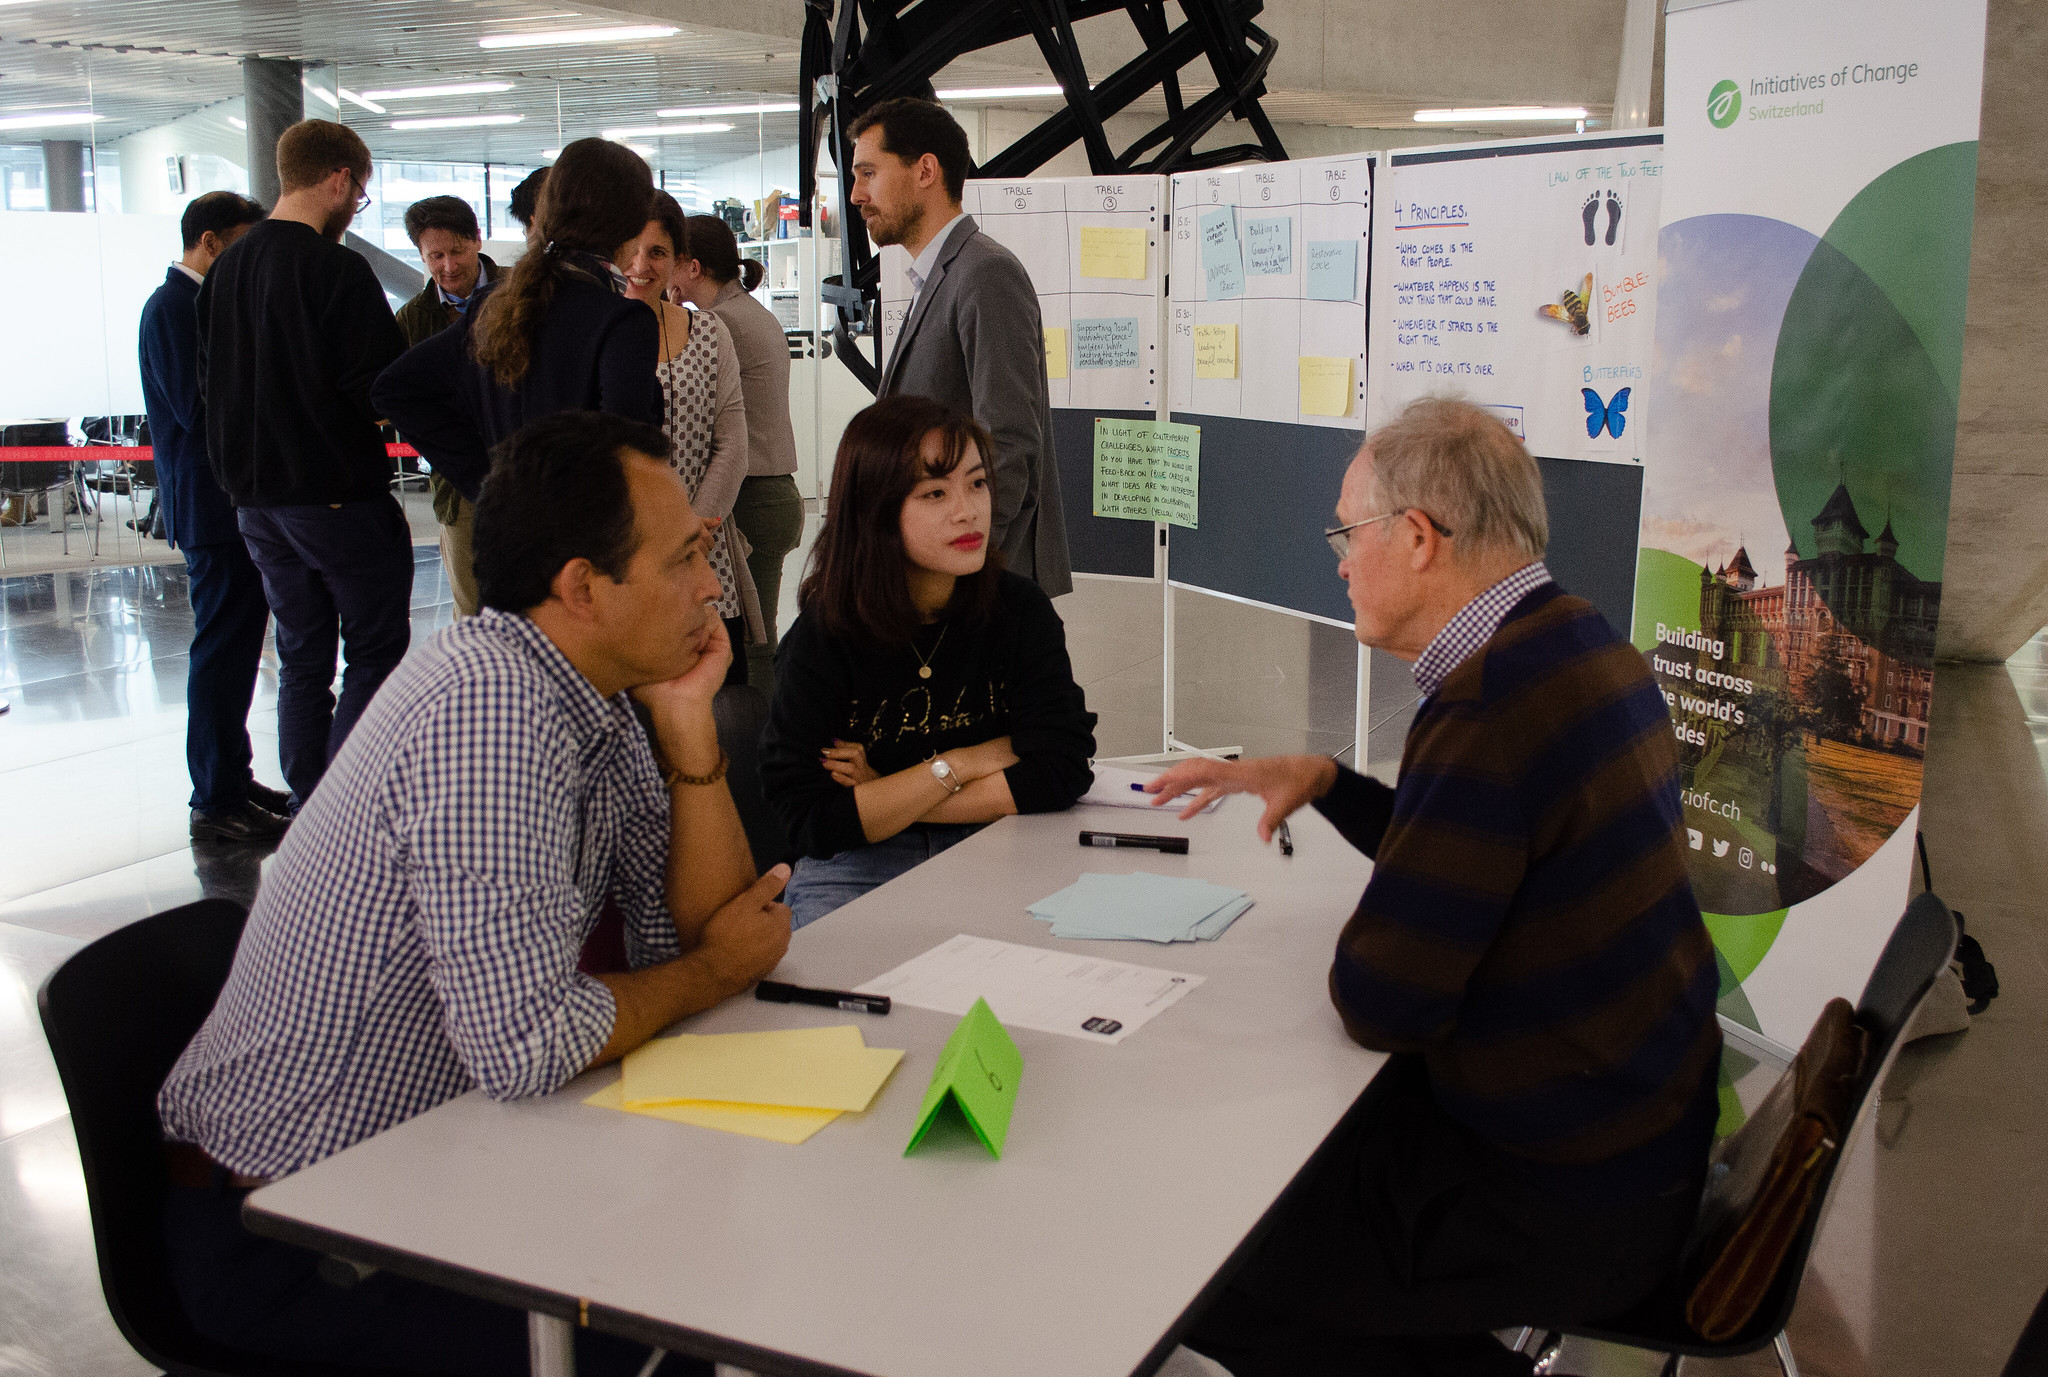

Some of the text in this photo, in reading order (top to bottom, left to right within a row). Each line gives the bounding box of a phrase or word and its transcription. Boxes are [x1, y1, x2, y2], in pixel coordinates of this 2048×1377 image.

[1750, 62, 1918, 97] Initiatives of Change
[1749, 99, 1824, 121] Switzerland
[1255, 173, 1276, 183] TABLE
[1325, 170, 1347, 181] TABLE
[1548, 160, 1664, 187] LAW OF THE TWO FEET
[1207, 177, 1220, 187] TABLE
[1003, 187, 1033, 196] TABLE
[1094, 185, 1124, 195] TABLE
[1394, 200, 1402, 222] 4
[1422, 243, 1443, 254] COMES
[1449, 243, 1456, 253] IS
[1461, 242, 1473, 253] THE
[1401, 256, 1453, 268] RIGHT PEOPLE.
[1439, 280, 1469, 292] HAPPENS
[1473, 281, 1479, 292] IS
[1483, 280, 1496, 291] THE
[1399, 295, 1414, 305] ONLY
[1417, 294, 1435, 305] THING
[1438, 294, 1453, 305] THAT
[1455, 296, 1474, 305] COULD
[1607, 299, 1636, 323] BEES
[1077, 323, 1112, 337] Supporting
[1439, 320, 1446, 330] IT
[1447, 320, 1473, 332] STARTS
[1476, 322, 1484, 333] IS
[1487, 321, 1498, 332] THE
[1398, 334, 1419, 345] RIGHT
[1419, 360, 1432, 373] IT'S
[1457, 362, 1471, 374] IT'S
[1100, 425, 1190, 443] IN LIGHT OF CONTEMPORARY
[1100, 440, 1190, 458] CHALLENGES, WHAT PROJECTS
[1127, 456, 1142, 465] HAVE
[1147, 458, 1160, 466] THAT
[1100, 466, 1135, 477] FEED-BACK
[1137, 470, 1147, 478] ON
[1101, 480, 1119, 488] WHAT
[1122, 481, 1140, 490] IDEAS
[1144, 481, 1157, 490] ARE
[1170, 485, 1196, 498] INTERESTED
[1101, 492, 1108, 500] IN
[1113, 493, 1151, 504] DEVELOPING
[1101, 504, 1119, 513] WITH
[1122, 506, 1148, 515] OTHERS
[1655, 622, 1725, 660] Building
[1653, 654, 1753, 695] trust across
[1658, 683, 1745, 725] he world's
[1680, 787, 1741, 821] .iofc.ch
